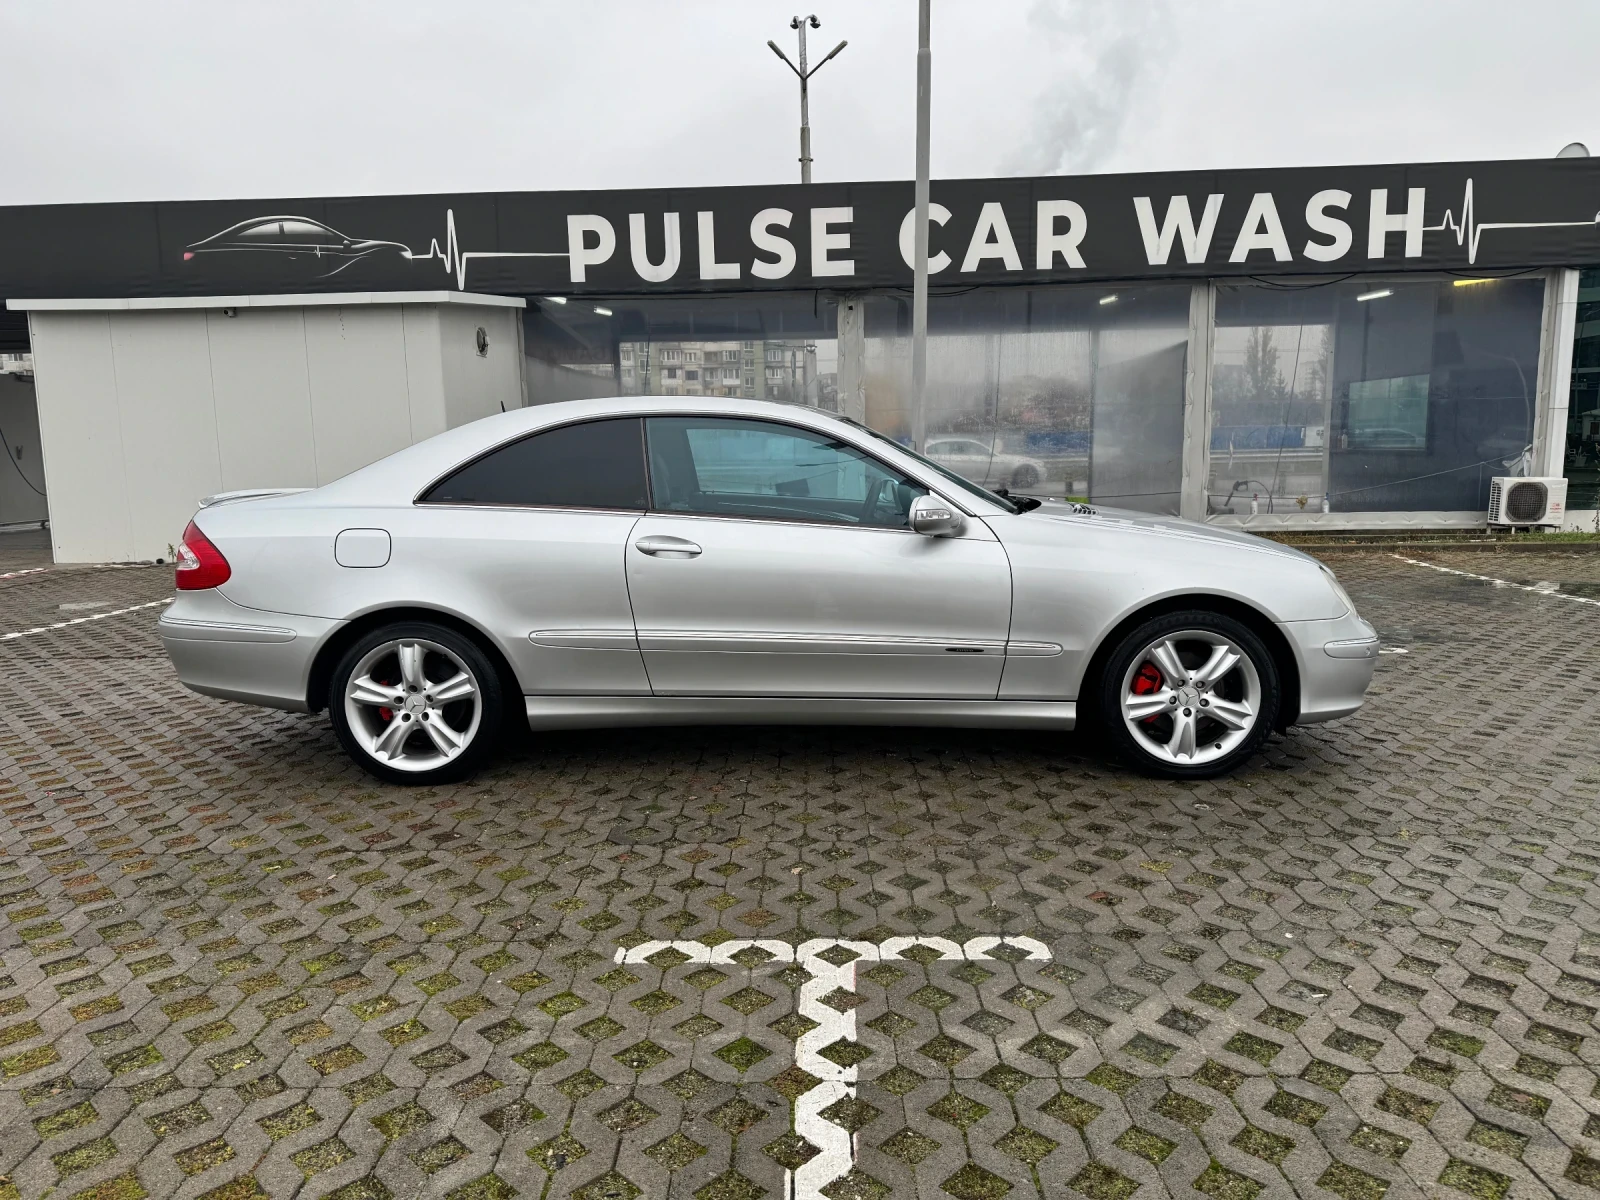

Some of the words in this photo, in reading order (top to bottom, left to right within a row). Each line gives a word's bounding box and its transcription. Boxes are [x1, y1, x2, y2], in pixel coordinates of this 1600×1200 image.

[566, 206, 856, 283] PULSE
[898, 199, 1088, 275] CAR
[1133, 188, 1425, 266] WASH
